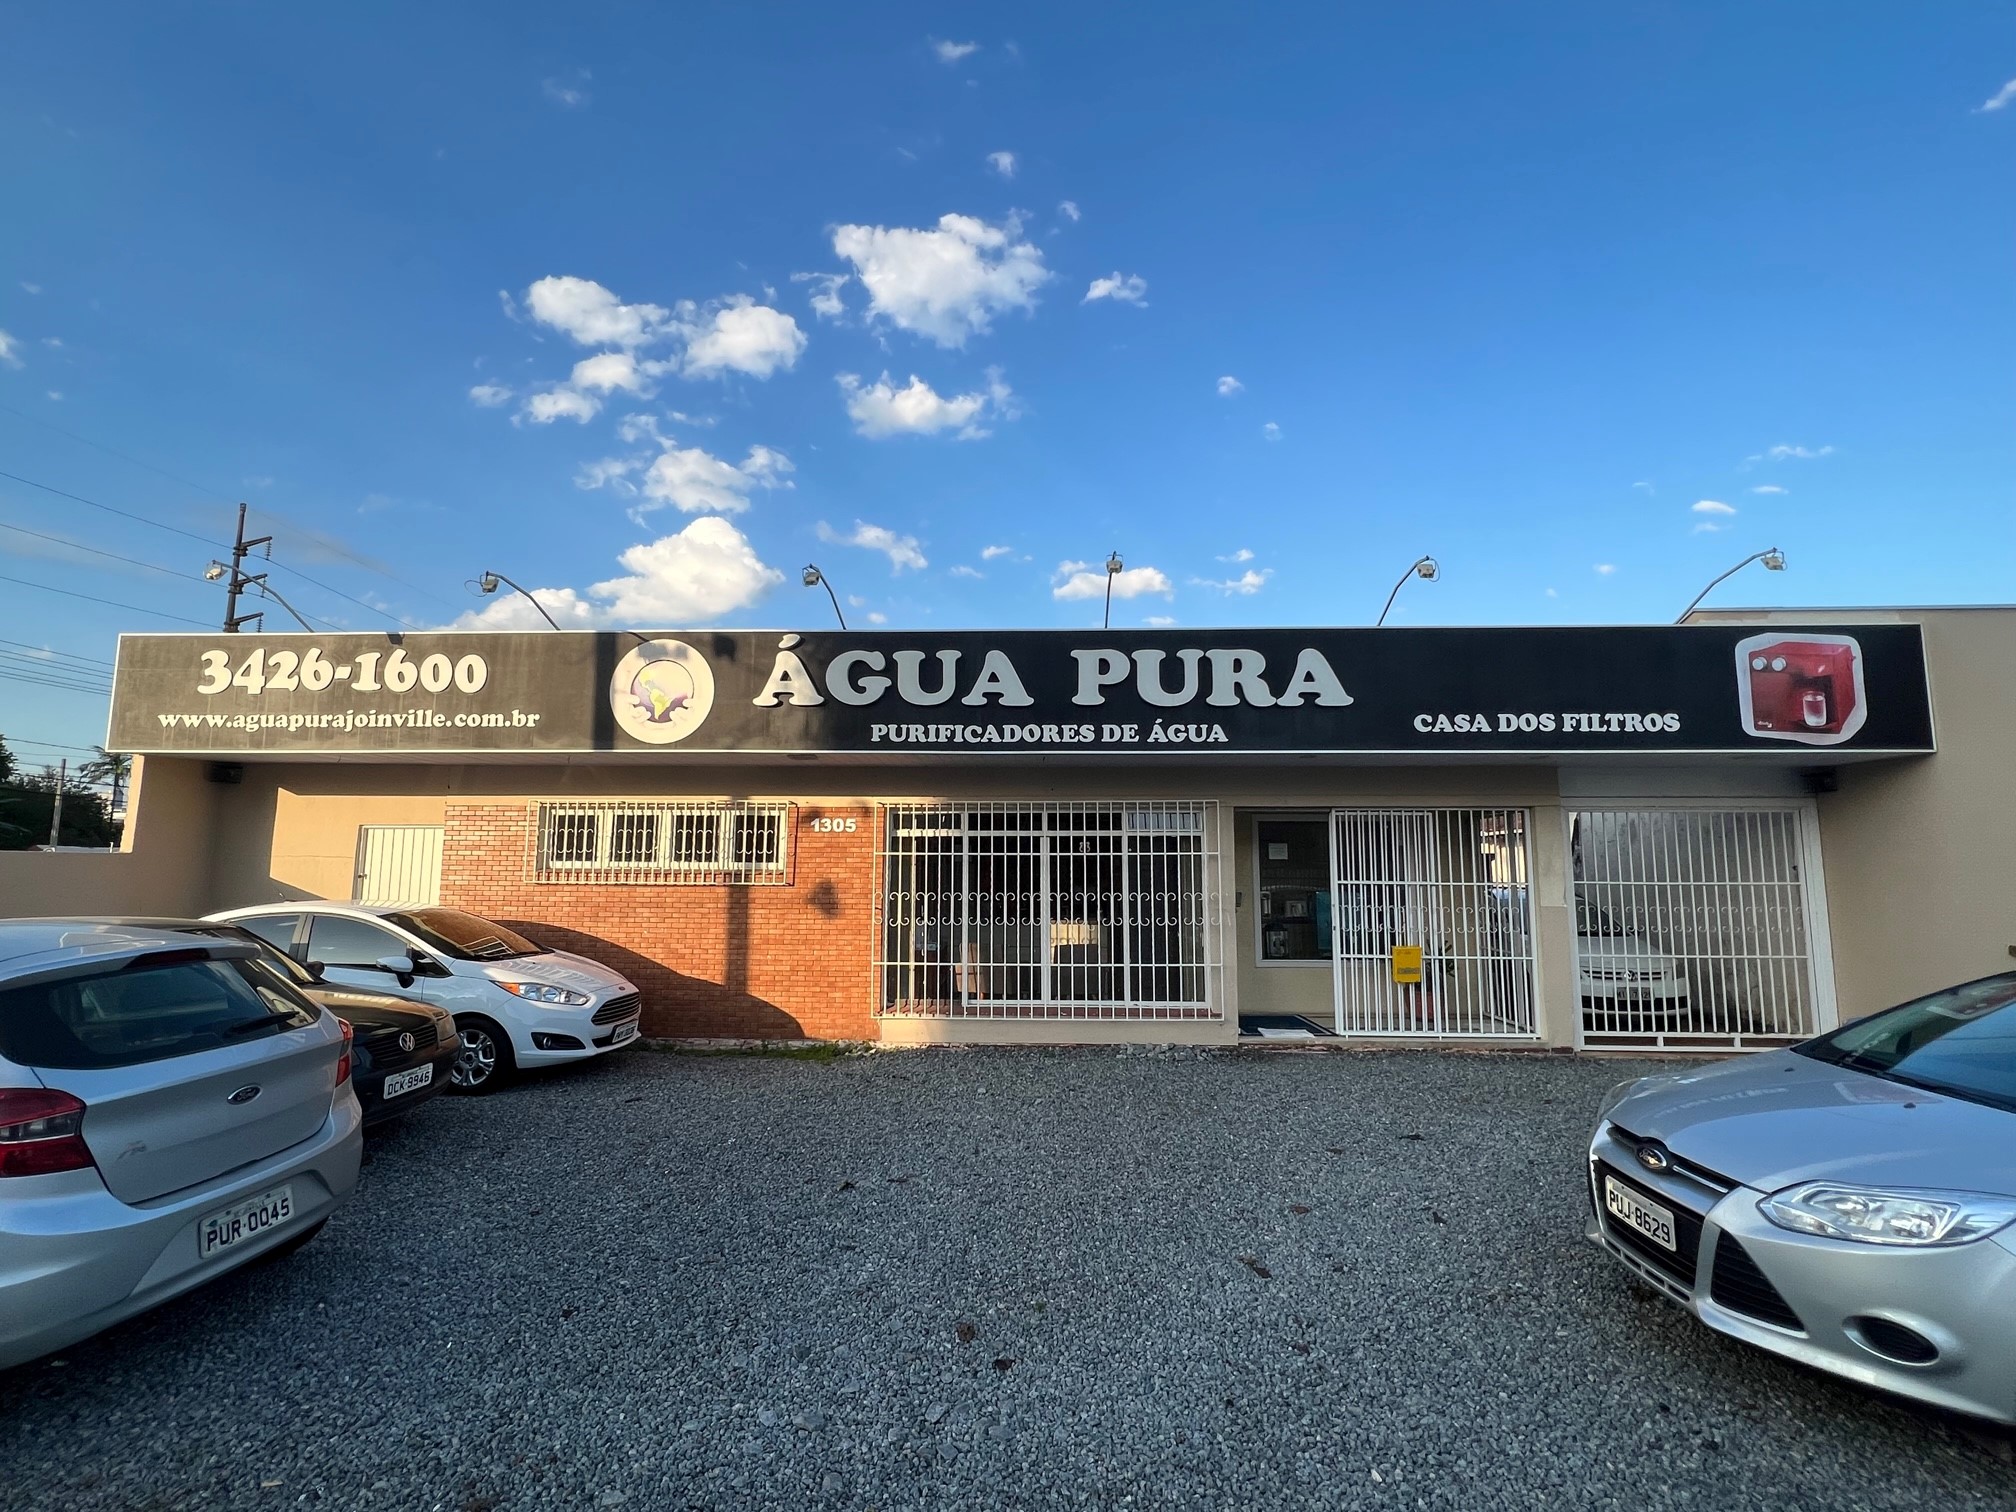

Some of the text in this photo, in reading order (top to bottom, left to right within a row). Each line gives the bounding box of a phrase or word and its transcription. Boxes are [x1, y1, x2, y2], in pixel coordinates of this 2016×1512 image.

[197, 648, 489, 695] 3426-1600
[751, 633, 1355, 707] ÁGUA PURA
[157, 709, 541, 733] www.aguapurajoinville.com.br
[870, 718, 1230, 743] PURIFICADORES DE ÁGUA
[1413, 713, 1681, 732] CASA DOS FILTROS
[810, 817, 857, 833] 1305
